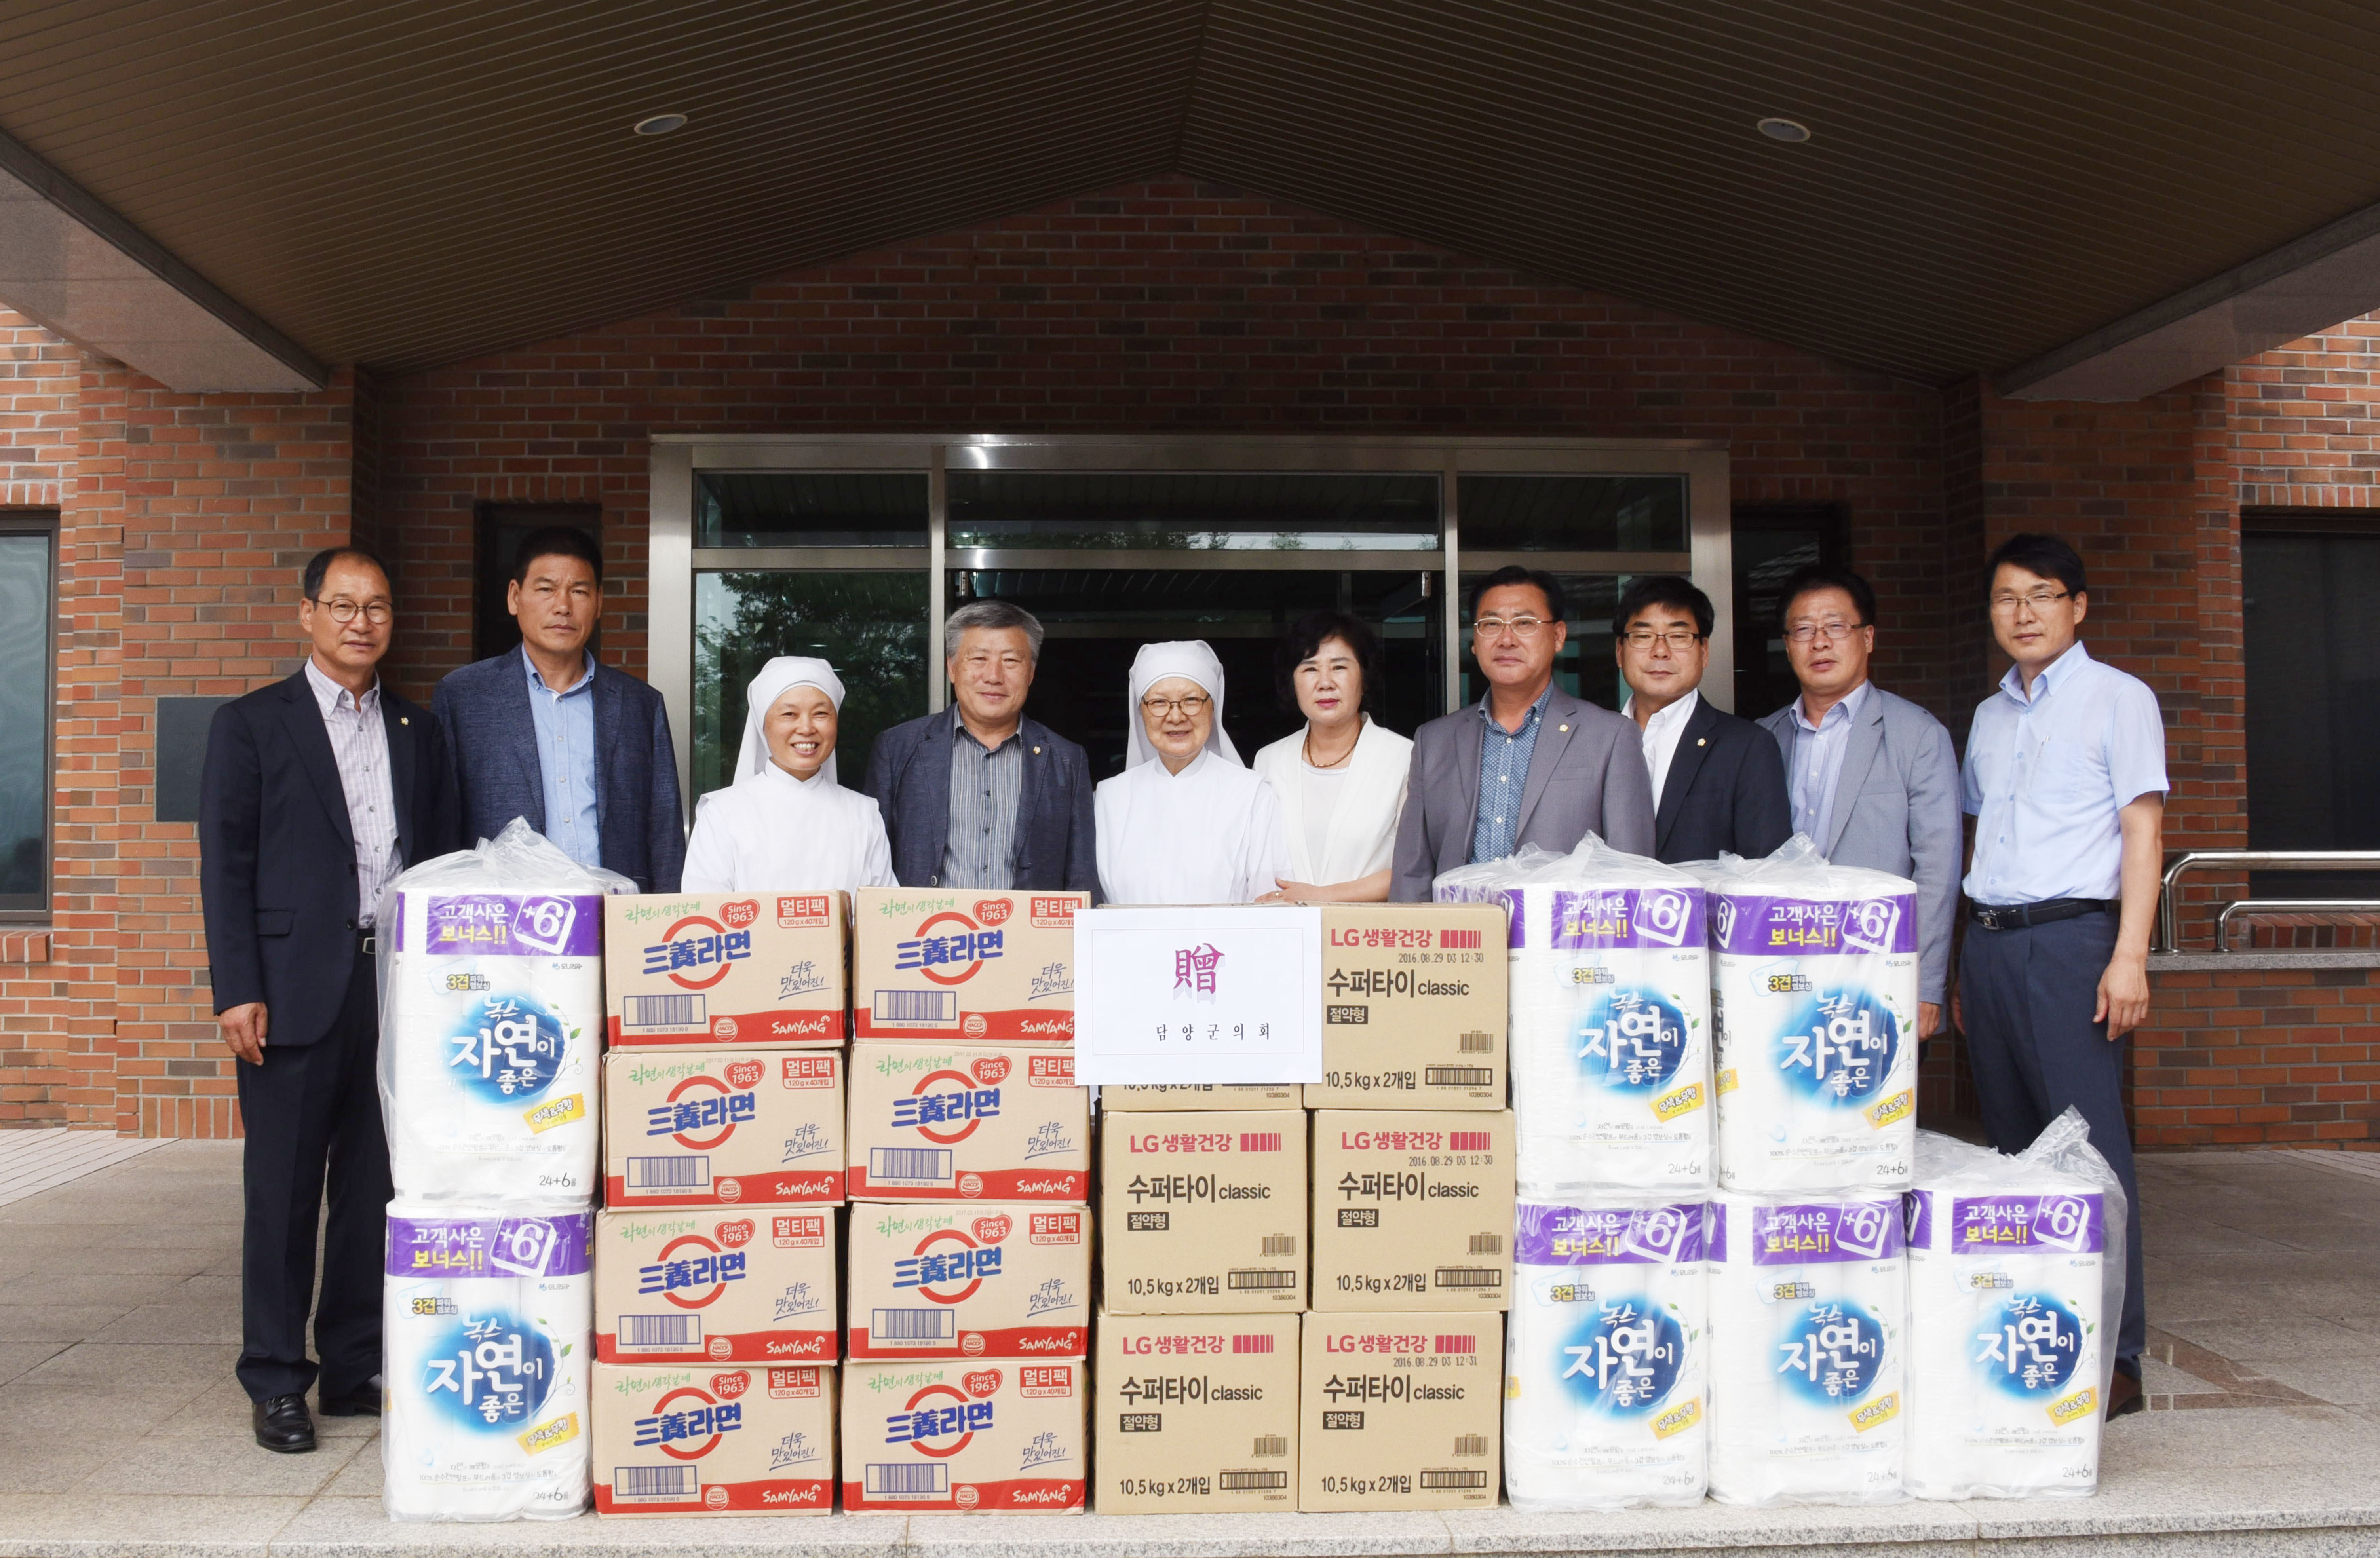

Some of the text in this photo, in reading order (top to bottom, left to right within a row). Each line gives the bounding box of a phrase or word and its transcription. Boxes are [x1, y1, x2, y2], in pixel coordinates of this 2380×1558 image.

[439, 903, 509, 924] 고객사은
[728, 904, 752, 913] Since
[781, 898, 825, 916] 멀티팩
[981, 909, 1008, 922] 1963
[982, 902, 1006, 912] Since
[1563, 897, 1629, 918] 고객사은
[1769, 905, 1837, 925] 고객사은
[727, 911, 754, 923] 1963
[440, 926, 506, 944] 보너스!!
[1563, 919, 1628, 938] 보너스!!
[1331, 928, 1433, 948] LG 생활건강
[1769, 928, 1836, 948] 보너스!!
[643, 930, 751, 975] 三養라면
[895, 927, 1003, 971] 三養라면
[1398, 953, 1443, 964] 2016.08.29
[1461, 953, 1484, 963] 12:30
[791, 961, 816, 978] 더욱
[1173, 943, 1225, 994] 贈
[446, 974, 470, 990] 3겹
[781, 975, 825, 994] 맛있어진!
[1031, 976, 1074, 994] 맛있어진!
[1327, 968, 1469, 998] 수퍼타이 classic
[1768, 975, 1792, 992] 3겹
[483, 994, 520, 1021] 녹스
[1817, 989, 1853, 1017] 녹스
[1330, 1007, 1365, 1022] 절약형
[772, 1019, 826, 1035] SAMYANG
[1020, 1020, 1074, 1035] SAMYANG
[733, 1065, 757, 1074] Since
[787, 1059, 831, 1077] 멀티팩
[876, 1056, 911, 1076] 라면이
[979, 1068, 1005, 1081] 1963
[980, 1061, 1004, 1070] Since
[1033, 1058, 1075, 1076] 멀티팩
[496, 1068, 537, 1094] 좋은
[628, 1065, 663, 1085] 라면이
[732, 1072, 759, 1085] 1963
[1383, 1070, 1416, 1090] 2개입
[532, 1098, 573, 1124] 무색&무향
[646, 1091, 755, 1136] 三養라면
[892, 1085, 1000, 1130] 三養라면
[795, 1123, 820, 1140] 더욱
[785, 1137, 829, 1155] 맛있어진!
[1028, 1136, 1071, 1154] 맛있어진!
[1130, 1134, 1232, 1153] LG 생활건강
[1342, 1132, 1443, 1150] LG 생활건강
[1409, 1155, 1453, 1167] 2016.08.29
[1471, 1155, 1493, 1165] 12:30
[775, 1181, 829, 1196] SAMYANG
[1016, 1179, 1070, 1194] SAMYANG
[1127, 1174, 1271, 1203] 수퍼타이 classic
[1338, 1171, 1479, 1201] 수퍼타이 classic
[1131, 1214, 1166, 1229] 절약형
[1341, 1211, 1375, 1226] 절약형
[1965, 1204, 2028, 1224] 고객사은
[723, 1224, 747, 1233] Since
[777, 1218, 821, 1236] 멀티팩
[979, 1226, 1006, 1239] 1963
[981, 1220, 1004, 1229] Since
[1033, 1215, 1077, 1233] 멀티팩
[1551, 1213, 1618, 1235] 고객사은
[1766, 1214, 1831, 1234] 고객사은
[412, 1226, 485, 1248] 고객사은
[722, 1230, 749, 1243] 1963
[1964, 1225, 2027, 1244] 보너스!!
[1551, 1237, 1619, 1257] 보너스!!
[1766, 1235, 1829, 1254] 보너스!!
[412, 1250, 483, 1270] 보너스!!
[893, 1244, 1002, 1289] 三養라면
[638, 1249, 746, 1295] 三養라면
[1040, 1278, 1065, 1295] 더욱
[1186, 1276, 1219, 1295] 2개입
[1393, 1273, 1426, 1292] 2개입
[412, 1298, 436, 1315] 3겹
[776, 1296, 819, 1315] 맛있어진!
[1030, 1292, 1073, 1311] 맛있어진!
[463, 1312, 502, 1342] 녹스
[766, 1340, 819, 1355] SAMYANG
[1019, 1336, 1072, 1351] SAMYANG
[1123, 1336, 1225, 1355] LG 생활건강
[1327, 1334, 1428, 1353] LG 생활건강
[1394, 1358, 1439, 1369] 2016.08.29
[1456, 1357, 1479, 1367] 12:31
[719, 1376, 743, 1385] Since
[772, 1369, 817, 1387] 멀티팩
[971, 1374, 994, 1383] Since
[1024, 1368, 1068, 1386] 멀티팩
[2021, 1363, 2058, 1389] 좋은
[718, 1382, 745, 1395] 1963
[970, 1381, 996, 1393] 1963
[1120, 1376, 1263, 1405] 수퍼타이 classic
[1323, 1374, 1464, 1403] 수퍼타이 classic
[479, 1394, 523, 1422] 좋은
[1856, 1397, 1893, 1422] 무색&무향
[633, 1402, 742, 1446] 三養라면
[885, 1399, 993, 1444] 三養라면
[1123, 1416, 1158, 1430] 절약형
[1326, 1413, 1360, 1428] 절약형
[782, 1432, 806, 1448] 더욱
[772, 1446, 815, 1464] 맛있어진!
[1022, 1445, 1066, 1463] 맛있어진!
[1177, 1476, 1210, 1495] 2개입
[1378, 1474, 1411, 1493] 2개입
[762, 1489, 816, 1504] SAMYANG
[1013, 1488, 1066, 1503] SAMYANG
